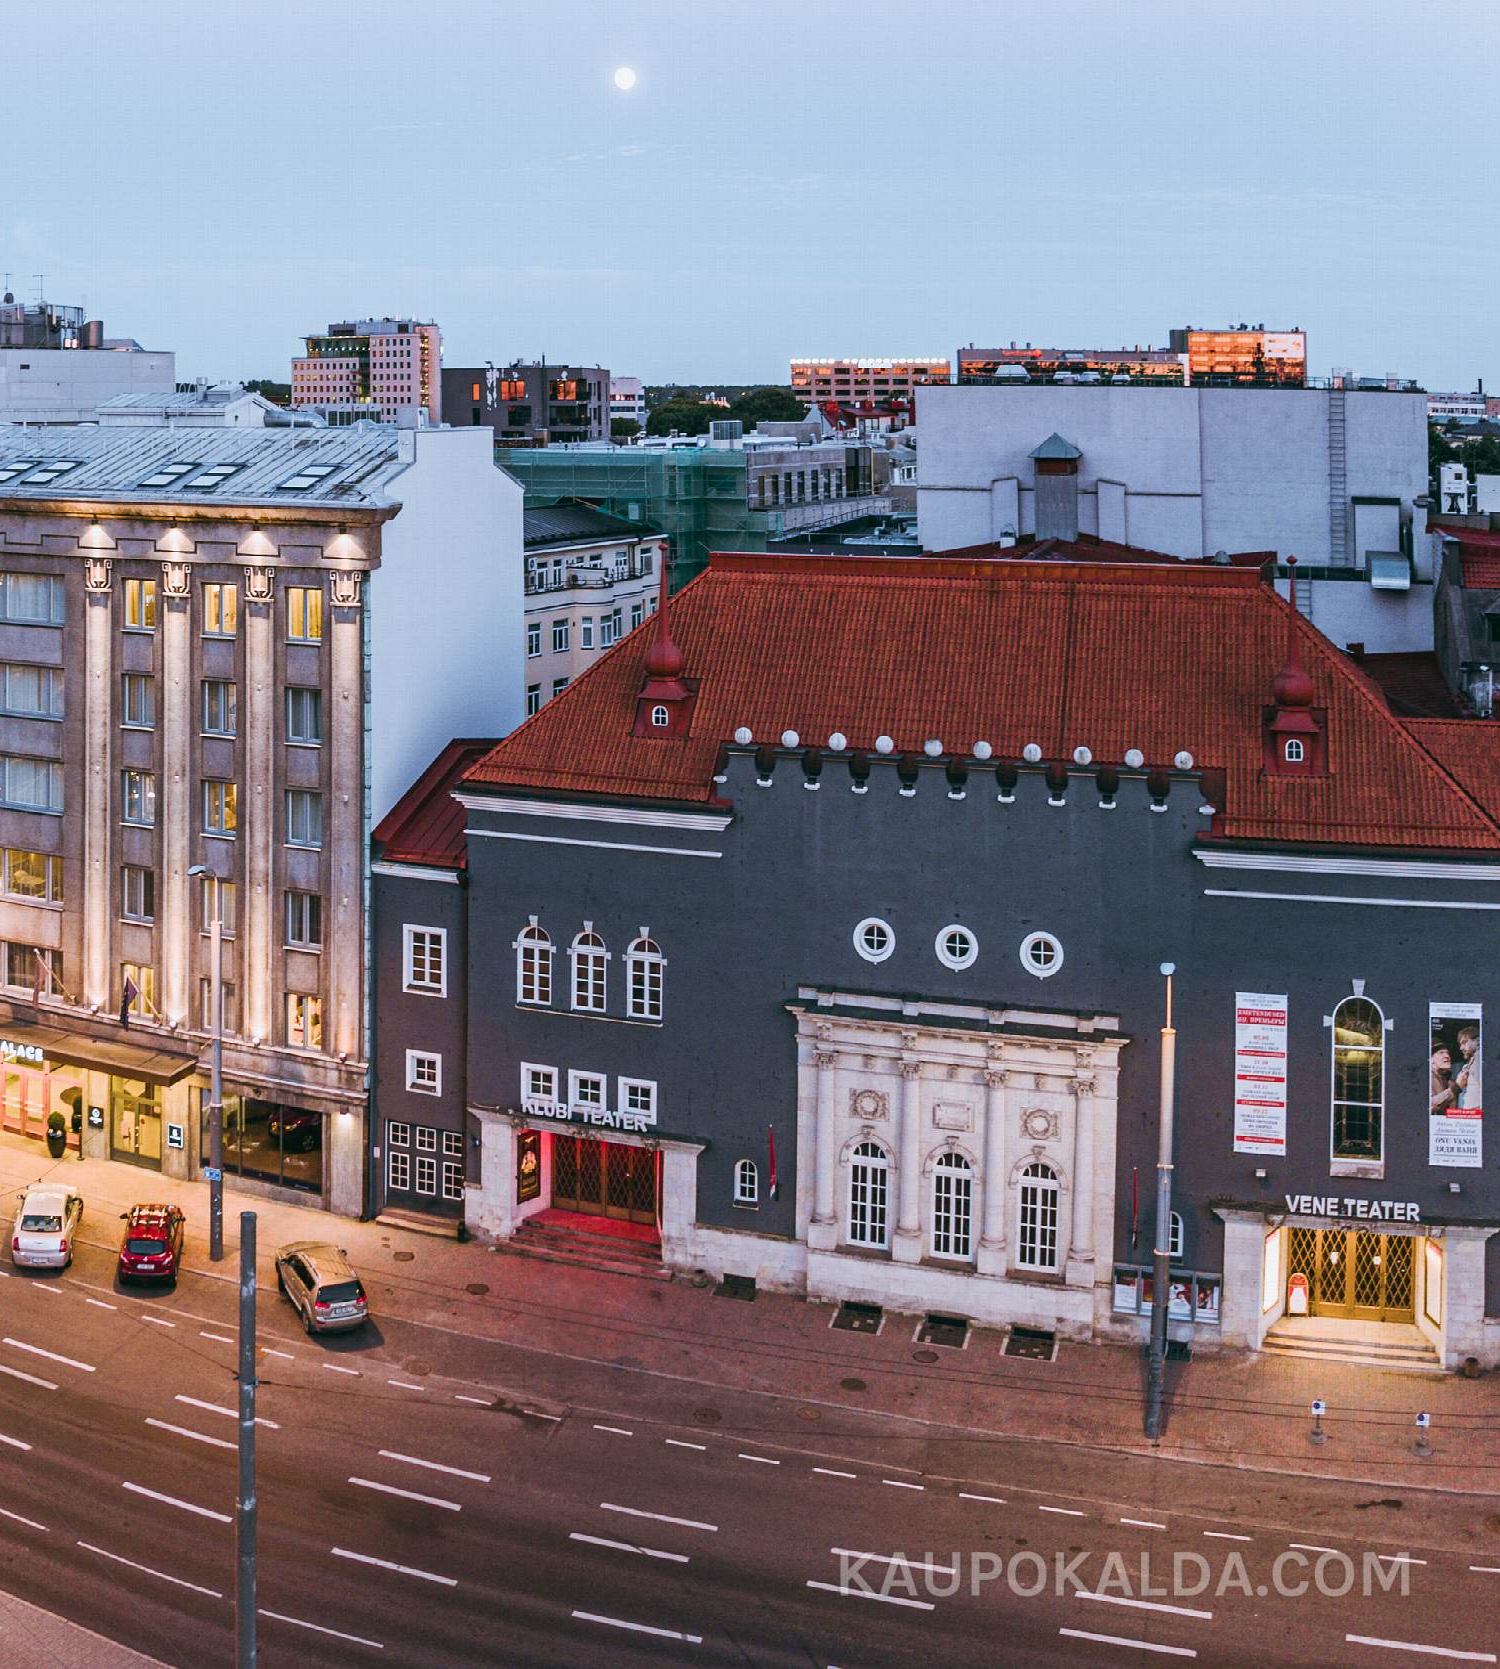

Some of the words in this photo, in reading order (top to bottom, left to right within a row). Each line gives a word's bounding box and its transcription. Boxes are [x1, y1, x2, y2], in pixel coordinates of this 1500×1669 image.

[521, 1100, 572, 1120] KLUBI
[579, 1106, 648, 1133] TEATER
[1285, 1194, 1339, 1217] VENE
[1343, 1198, 1421, 1222] TEATER
